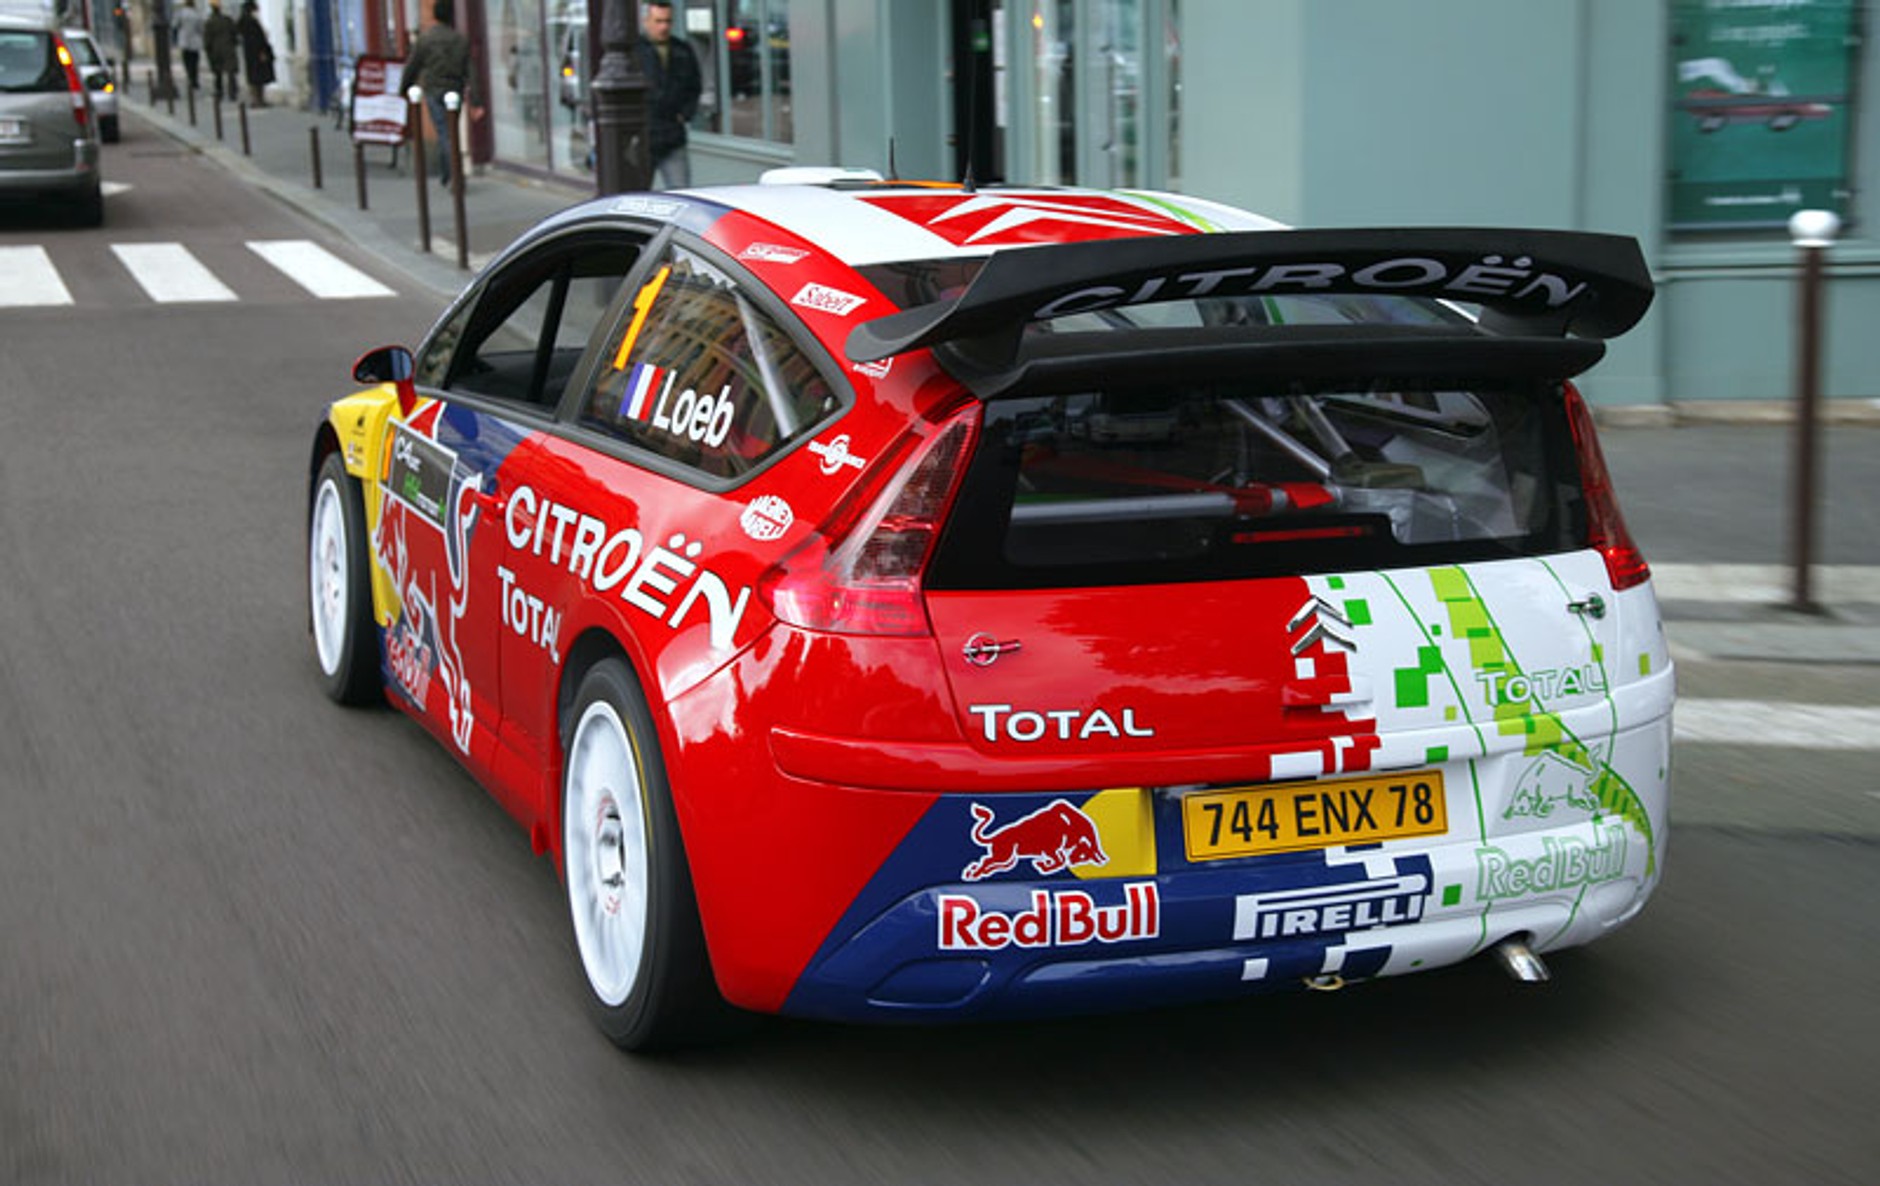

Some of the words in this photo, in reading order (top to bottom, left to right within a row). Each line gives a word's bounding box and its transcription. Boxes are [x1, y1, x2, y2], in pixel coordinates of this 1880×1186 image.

[612, 265, 672, 371] 1
[1034, 255, 1588, 319] CITROËN
[652, 369, 734, 448] Loeb
[504, 485, 752, 650] CITROËN
[1475, 664, 1608, 708] TOTAL
[969, 704, 1155, 742] TOTAL
[1203, 798, 1279, 847] 744
[1294, 788, 1378, 838] ENX
[1389, 782, 1434, 826] 78
[938, 890, 1050, 950] Red
[1053, 881, 1160, 947] Bull
[1232, 873, 1428, 941] PIRELLI
